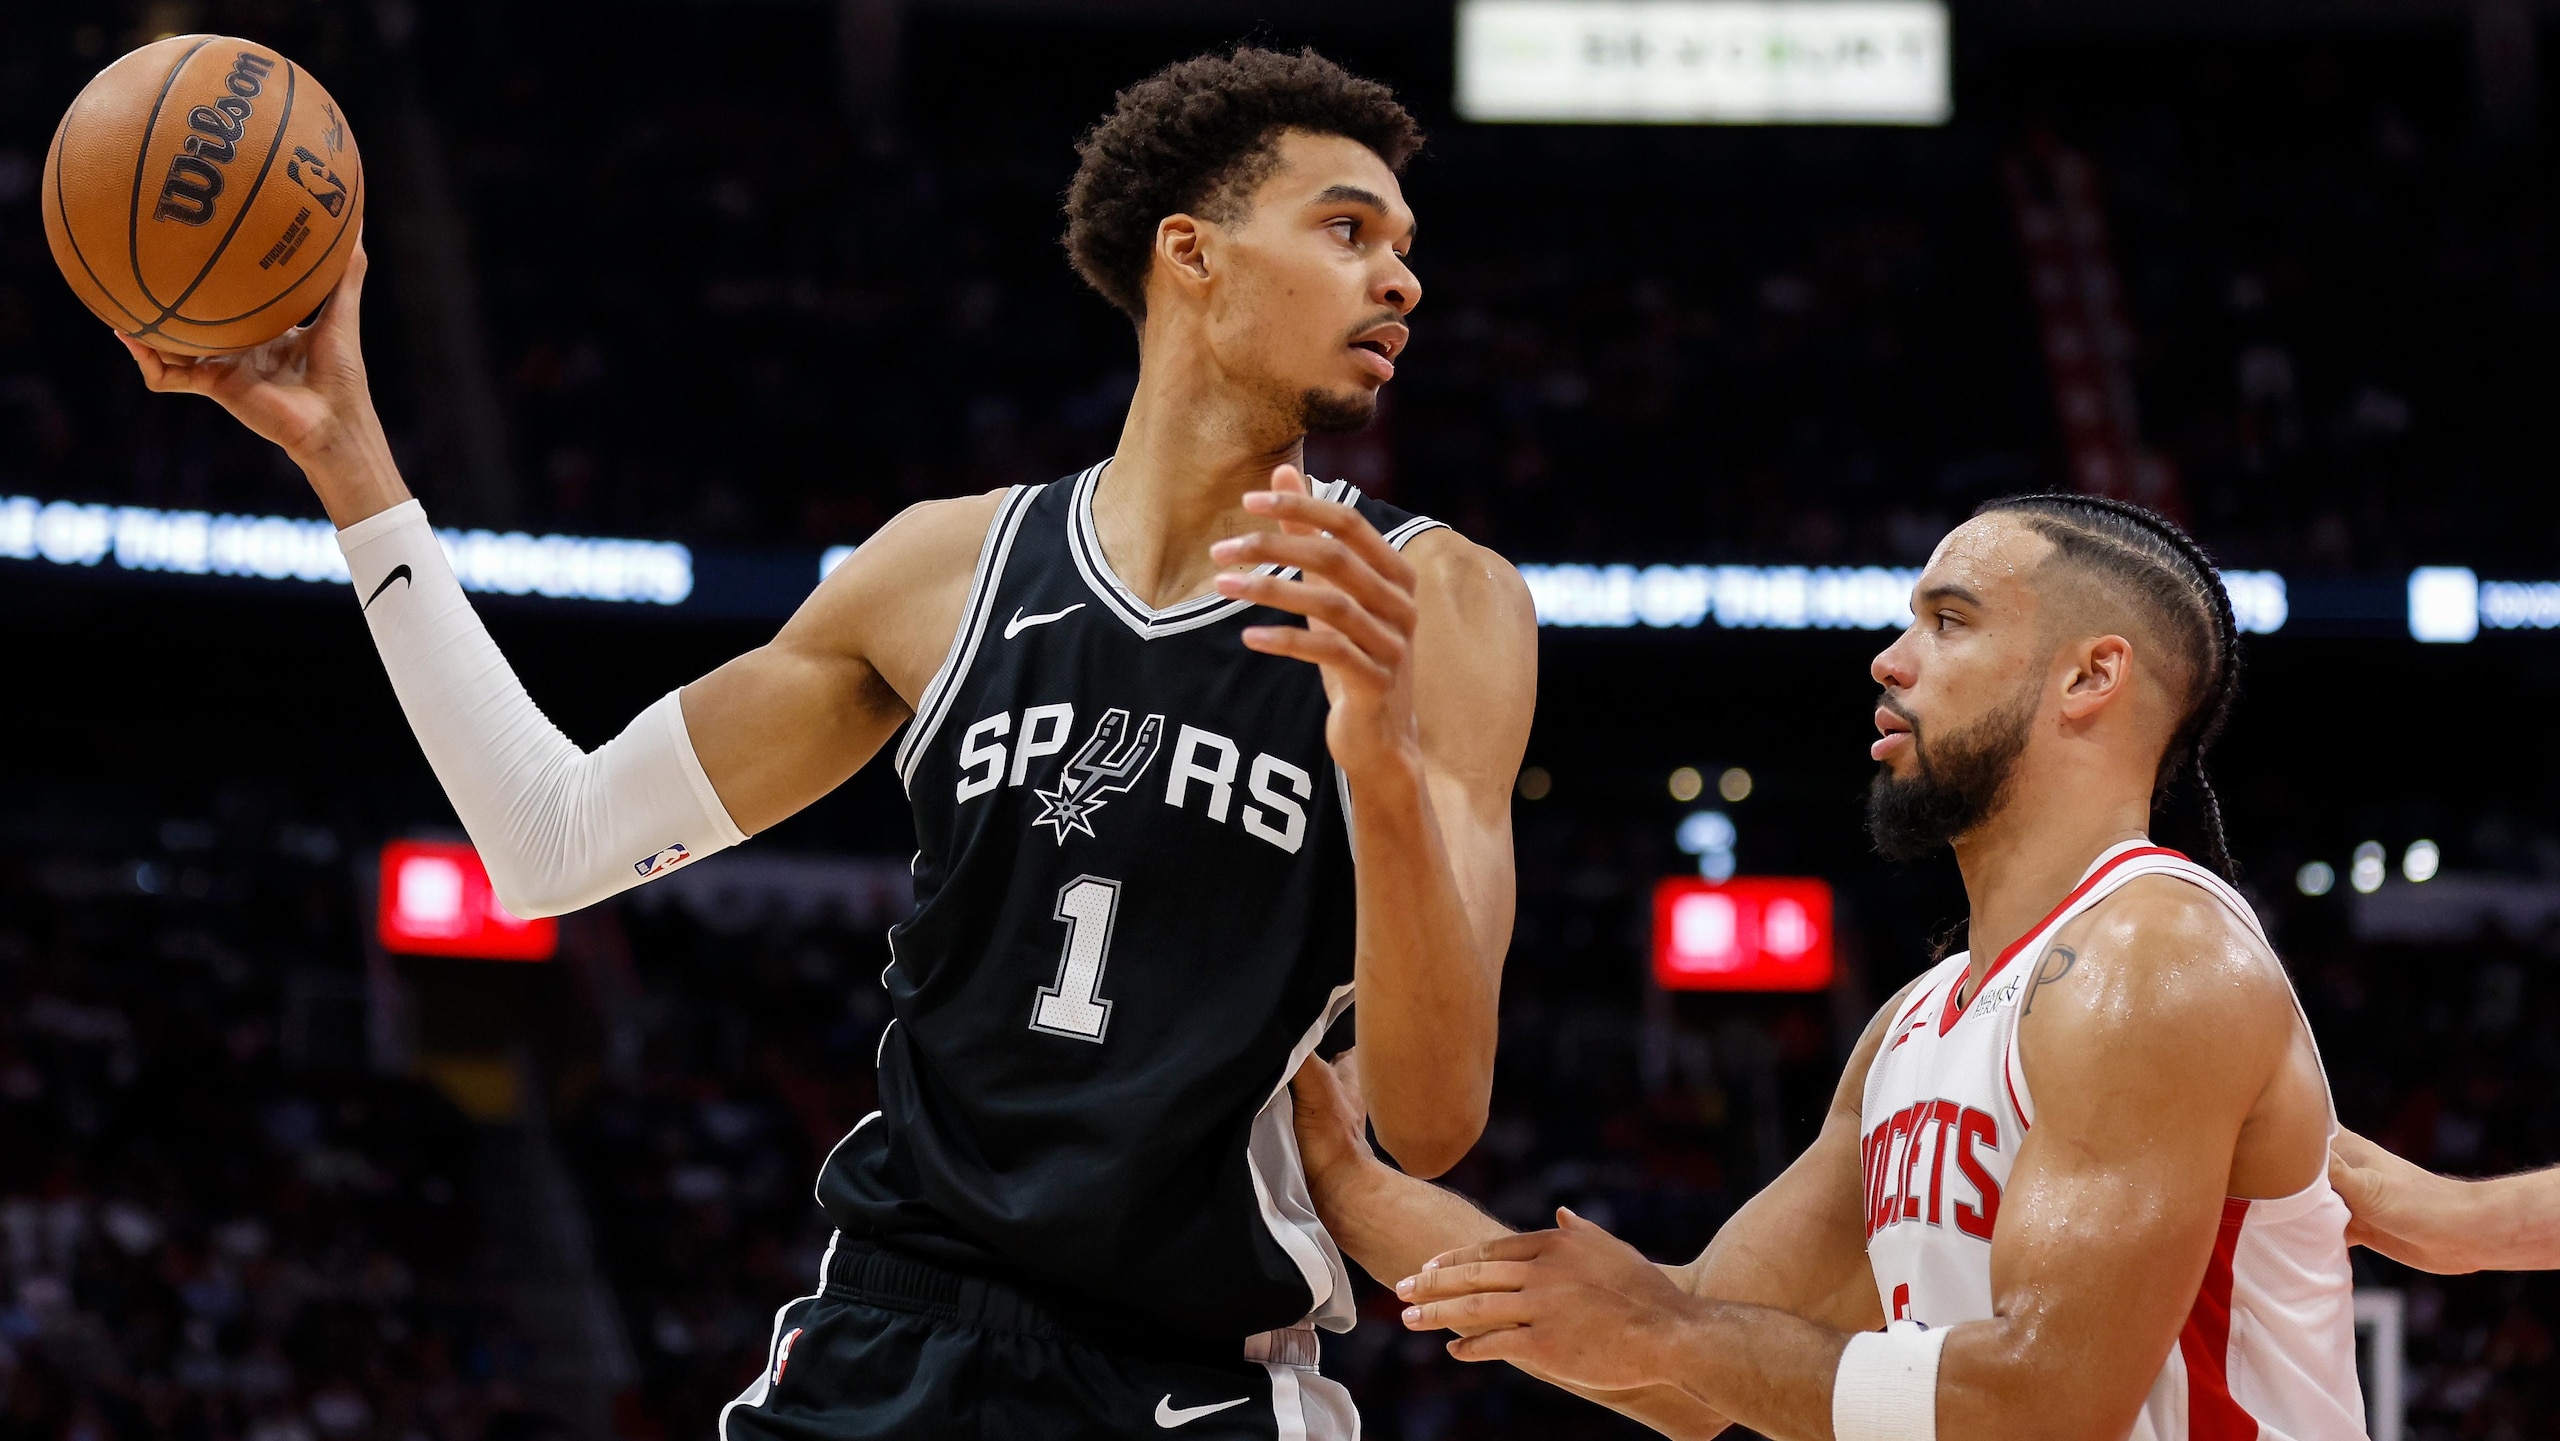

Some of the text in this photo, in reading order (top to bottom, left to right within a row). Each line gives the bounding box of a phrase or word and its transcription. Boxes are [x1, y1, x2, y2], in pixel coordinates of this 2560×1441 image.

[152, 51, 275, 227] Wilson
[956, 702, 1313, 855] SPURS
[1028, 874, 1122, 1045] 1
